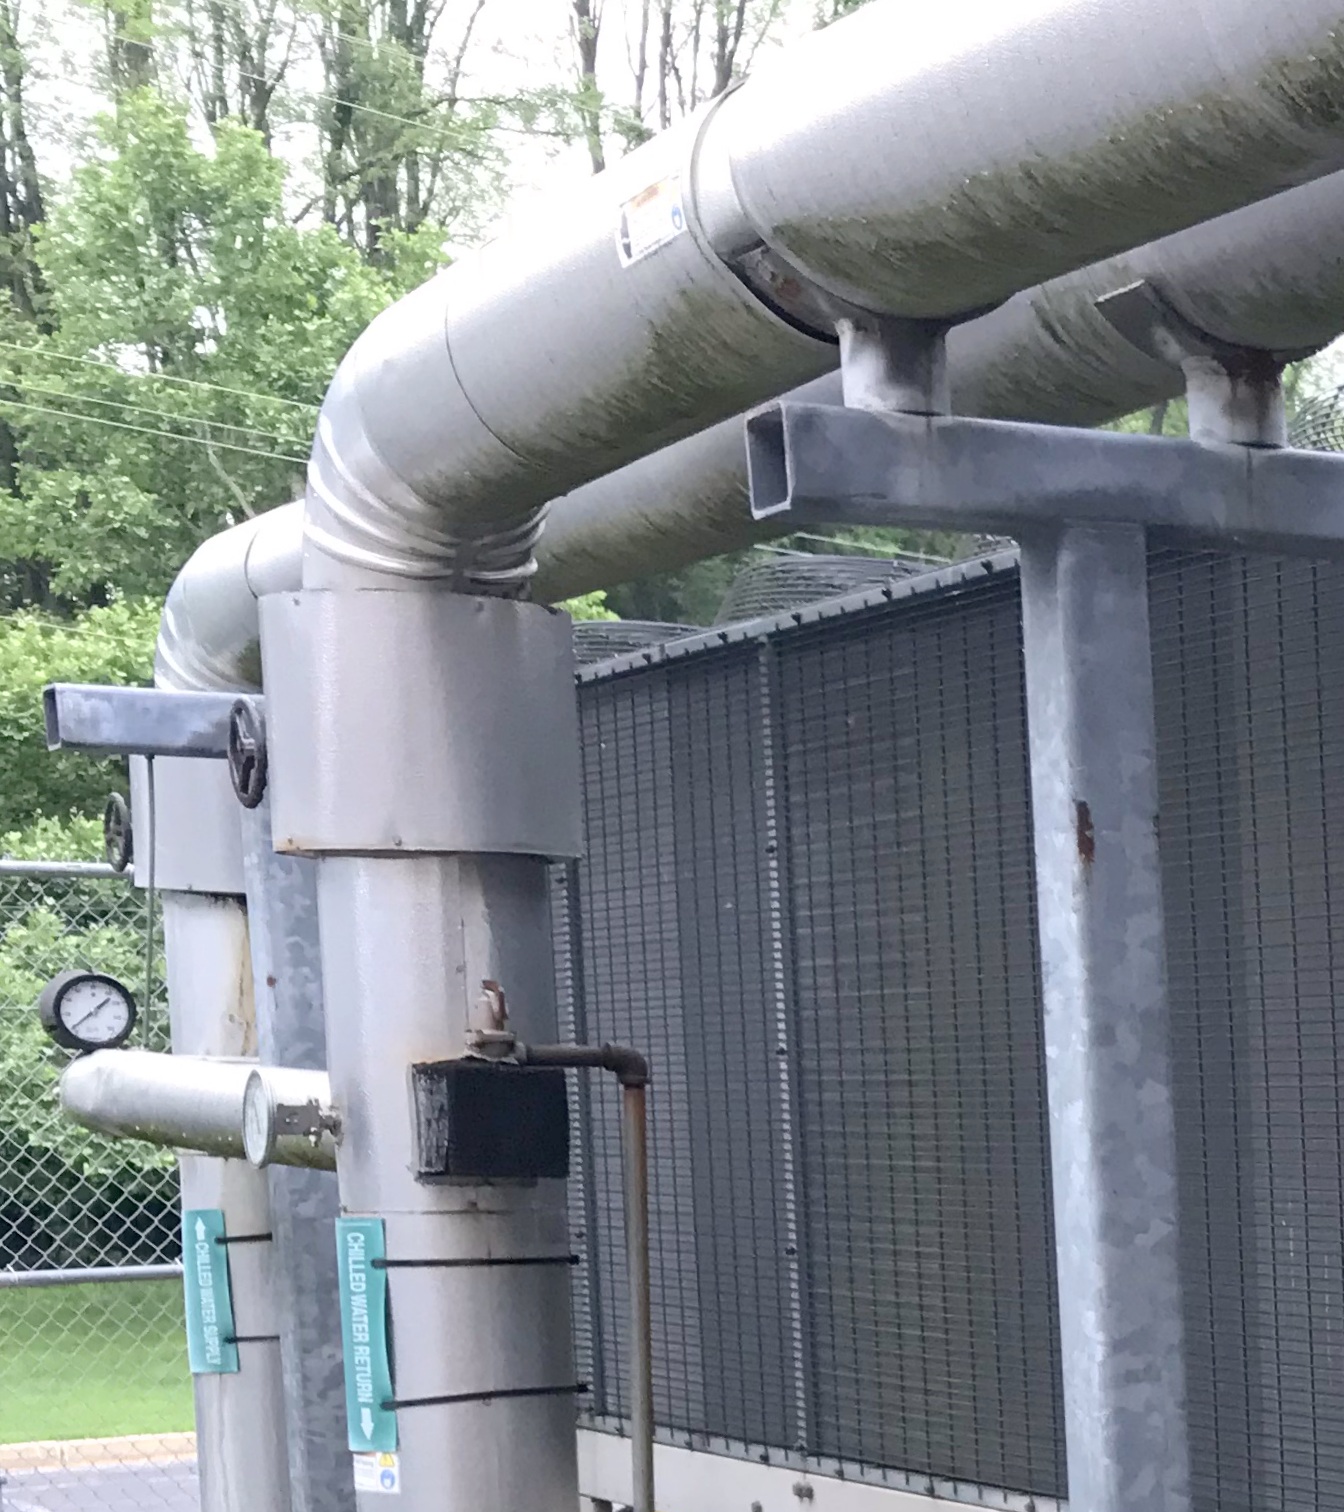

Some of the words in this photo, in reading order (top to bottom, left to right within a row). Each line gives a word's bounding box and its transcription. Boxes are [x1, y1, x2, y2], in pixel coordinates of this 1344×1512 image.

[195, 1241, 214, 1287] CHILLED
[346, 1232, 367, 1292] CHILLED
[199, 1287, 217, 1323] WATER
[350, 1294, 370, 1342] WATER
[203, 1324, 221, 1366] SUPPLY
[354, 1346, 374, 1403] RETURN
